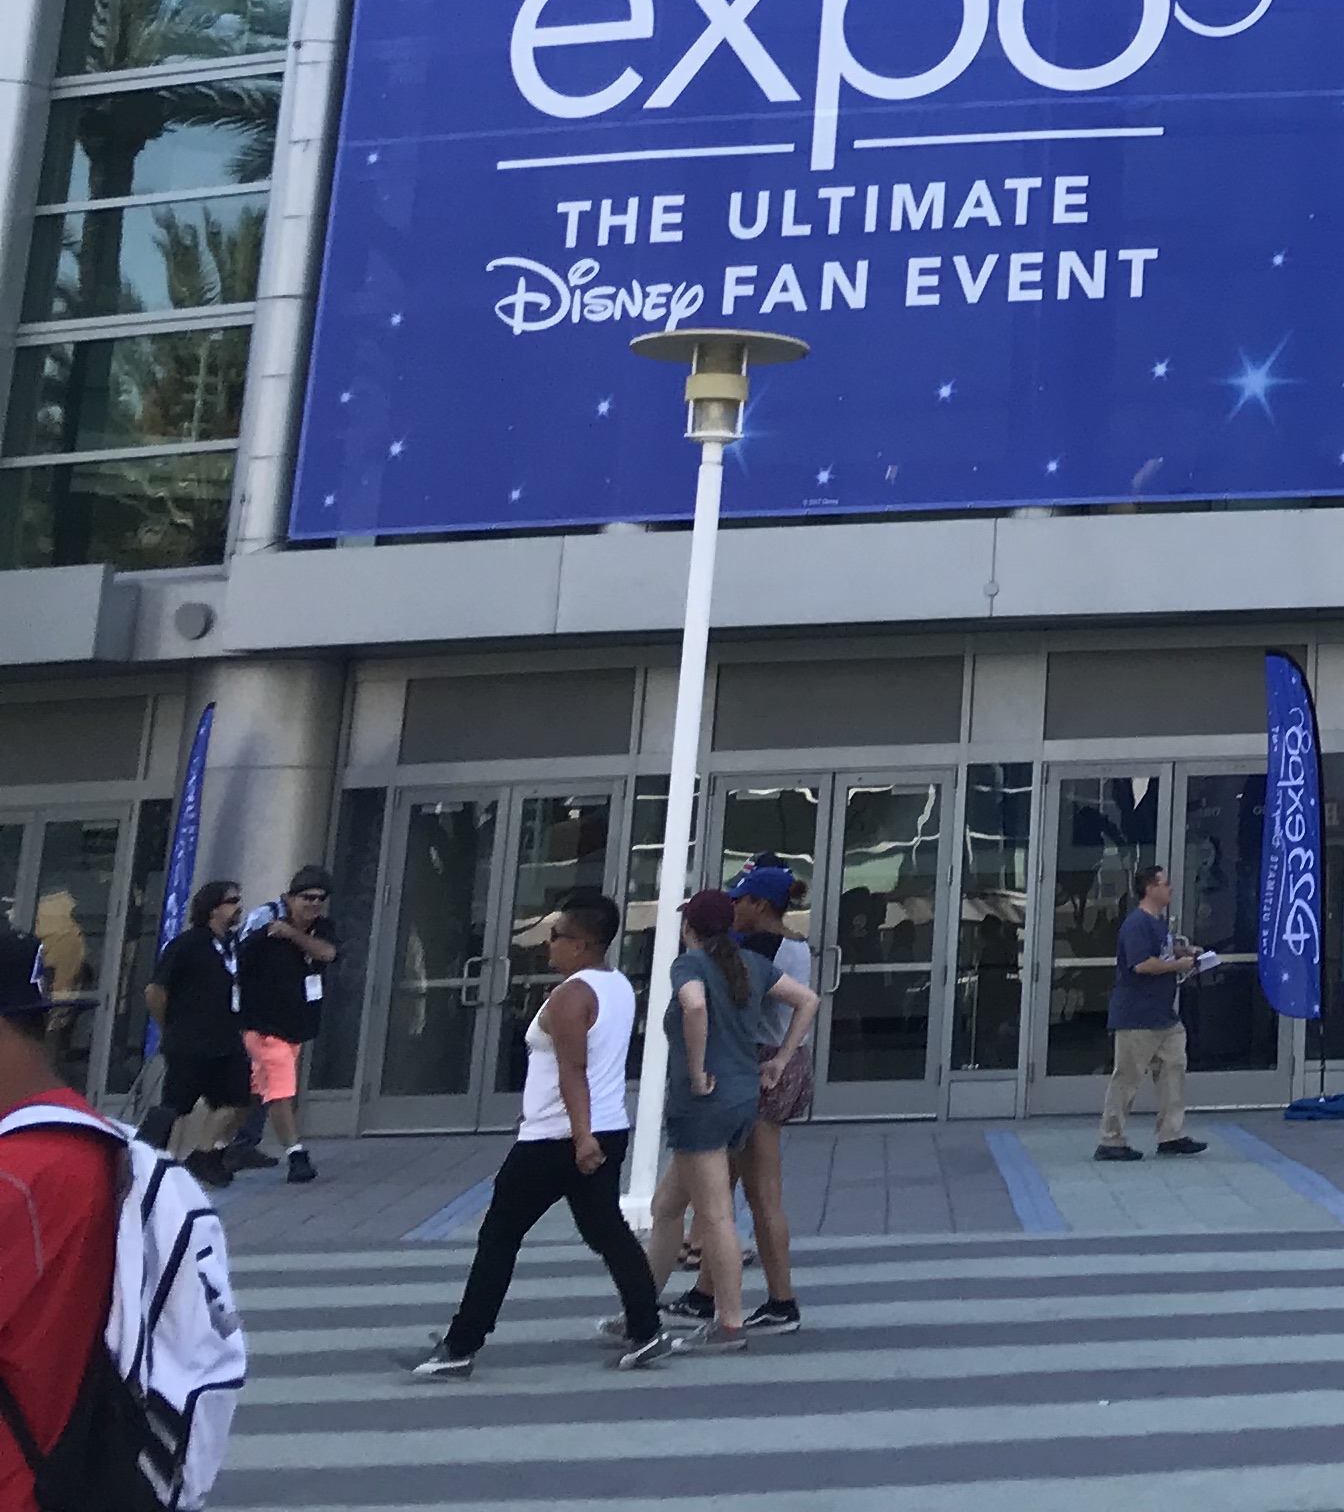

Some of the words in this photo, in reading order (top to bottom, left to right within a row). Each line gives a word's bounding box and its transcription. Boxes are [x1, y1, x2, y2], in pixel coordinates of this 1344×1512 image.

[556, 194, 685, 248] THE
[727, 175, 1090, 240] ULTIMATE
[485, 257, 704, 334] Disney
[721, 260, 869, 316] FAN
[905, 247, 1160, 308] EVENT
